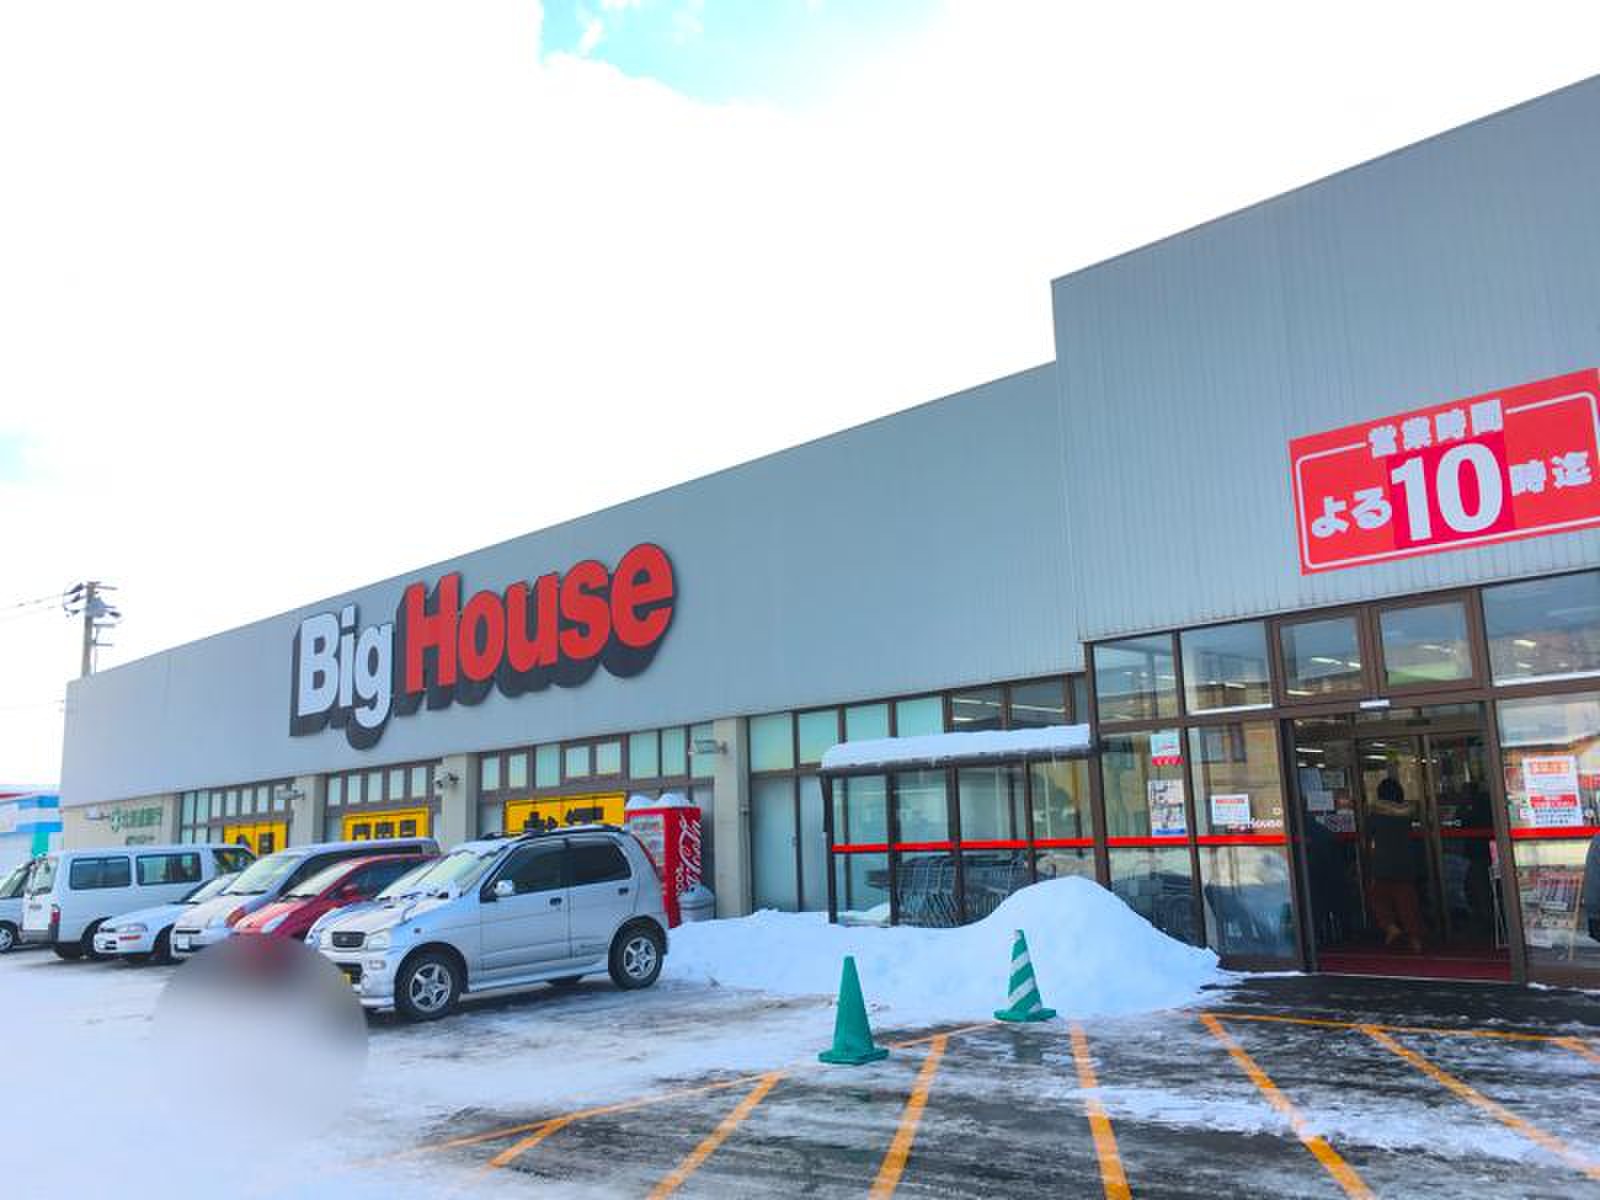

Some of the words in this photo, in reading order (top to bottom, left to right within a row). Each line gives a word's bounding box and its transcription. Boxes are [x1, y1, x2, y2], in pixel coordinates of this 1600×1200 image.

[1368, 399, 1504, 458] 営業時間
[298, 604, 393, 728] Big
[406, 542, 673, 693] House
